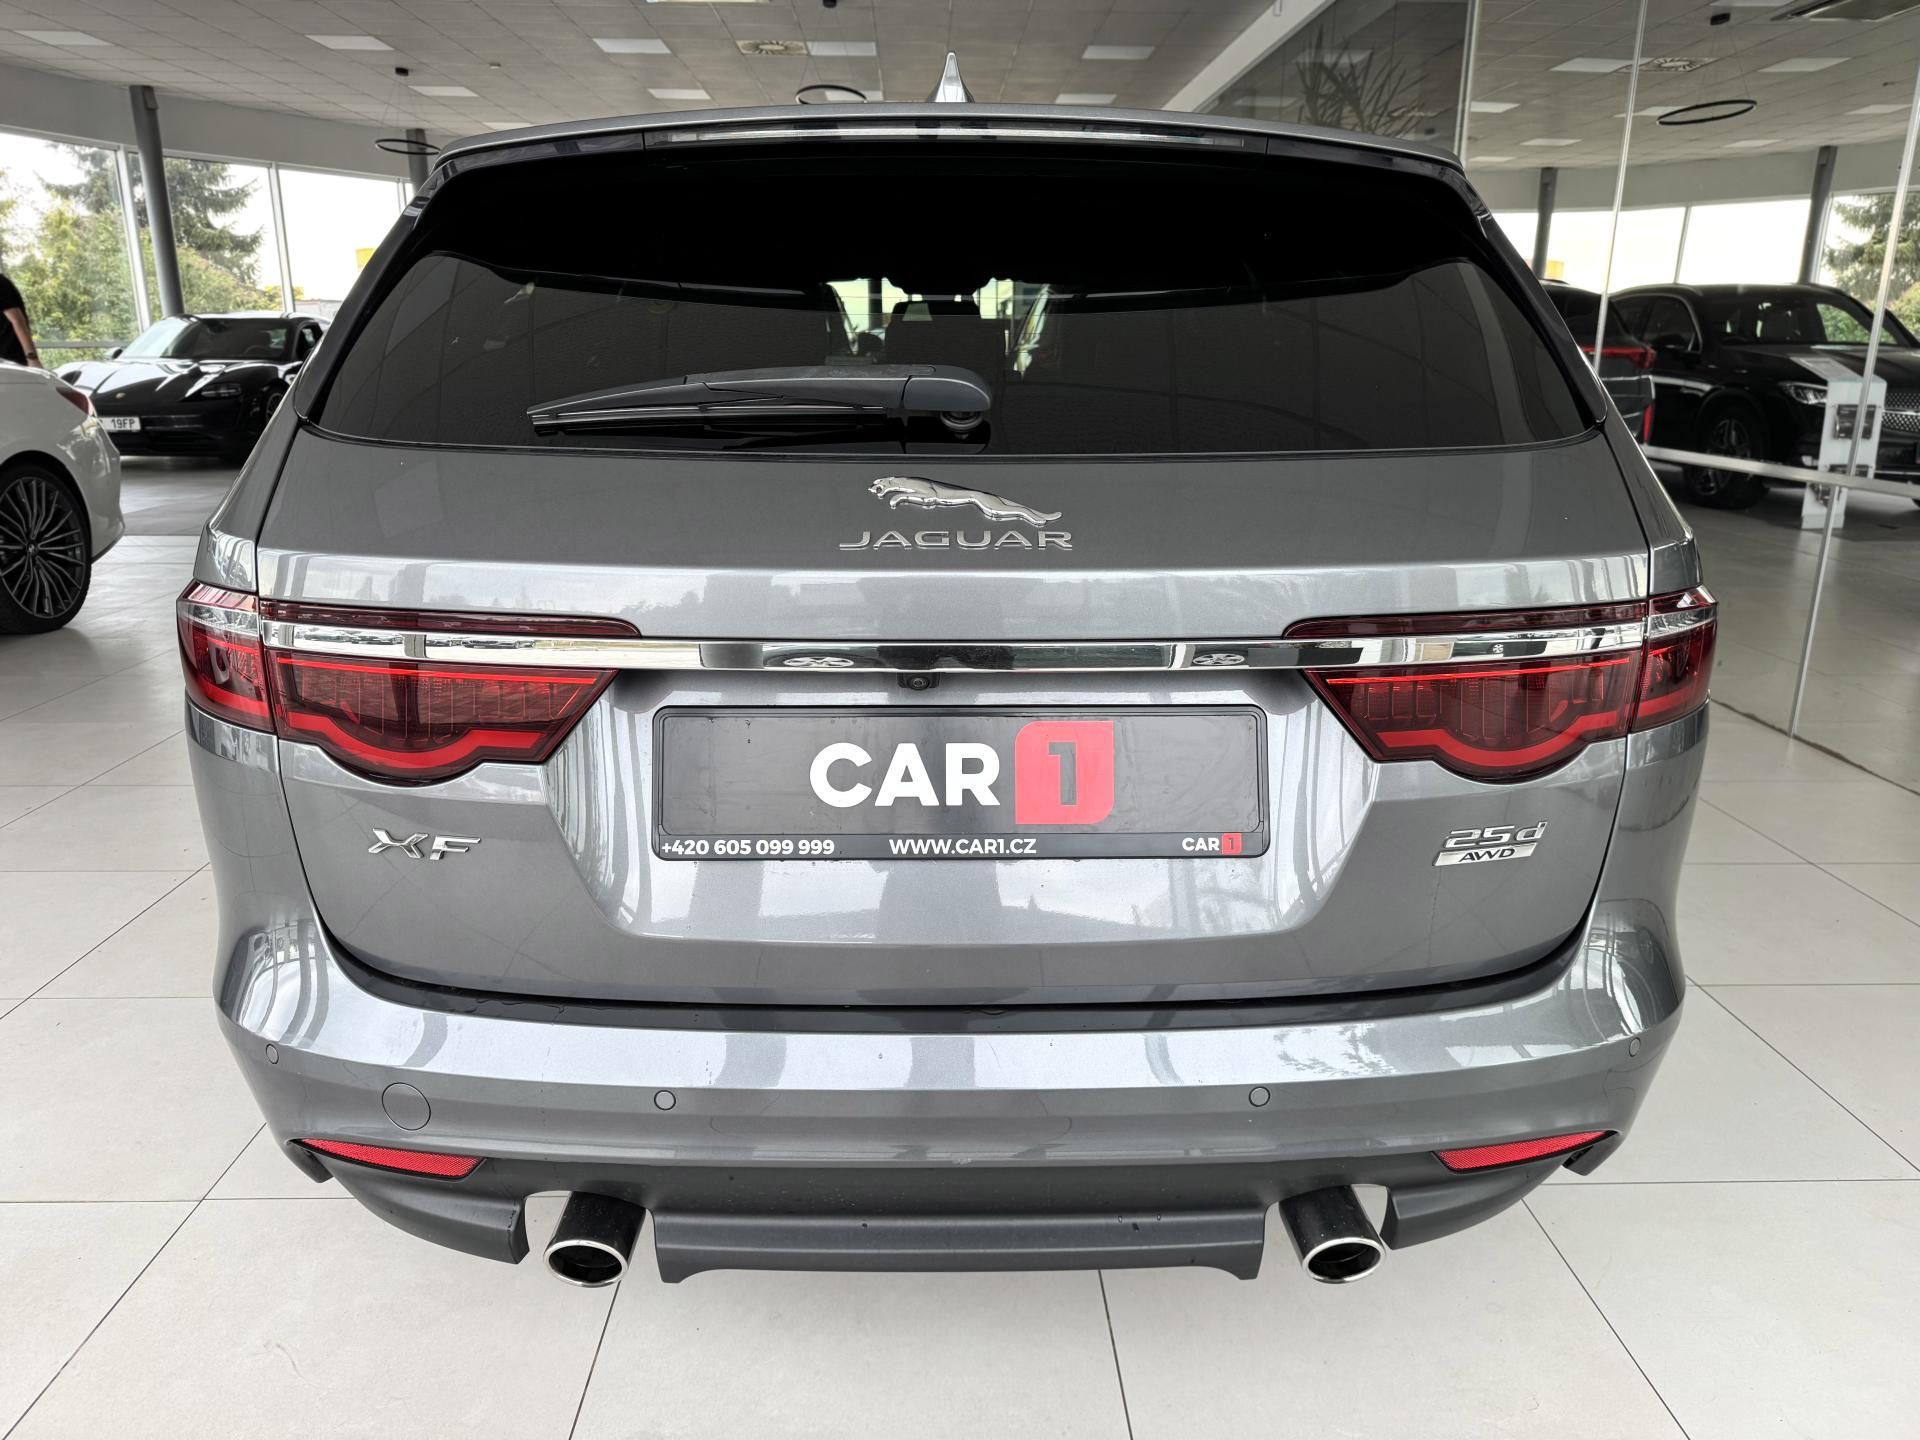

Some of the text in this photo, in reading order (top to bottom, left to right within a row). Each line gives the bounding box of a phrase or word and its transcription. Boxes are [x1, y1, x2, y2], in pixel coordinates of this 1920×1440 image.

[111, 418, 135, 429] 19FP
[839, 530, 1073, 551] JAGUAR
[1444, 821, 1548, 848] 25d
[368, 828, 481, 860] XF
[661, 839, 835, 855] +420 605 099 999
[888, 838, 1037, 855] WWW.CAR1.CZ
[1459, 848, 1516, 862] AWD
